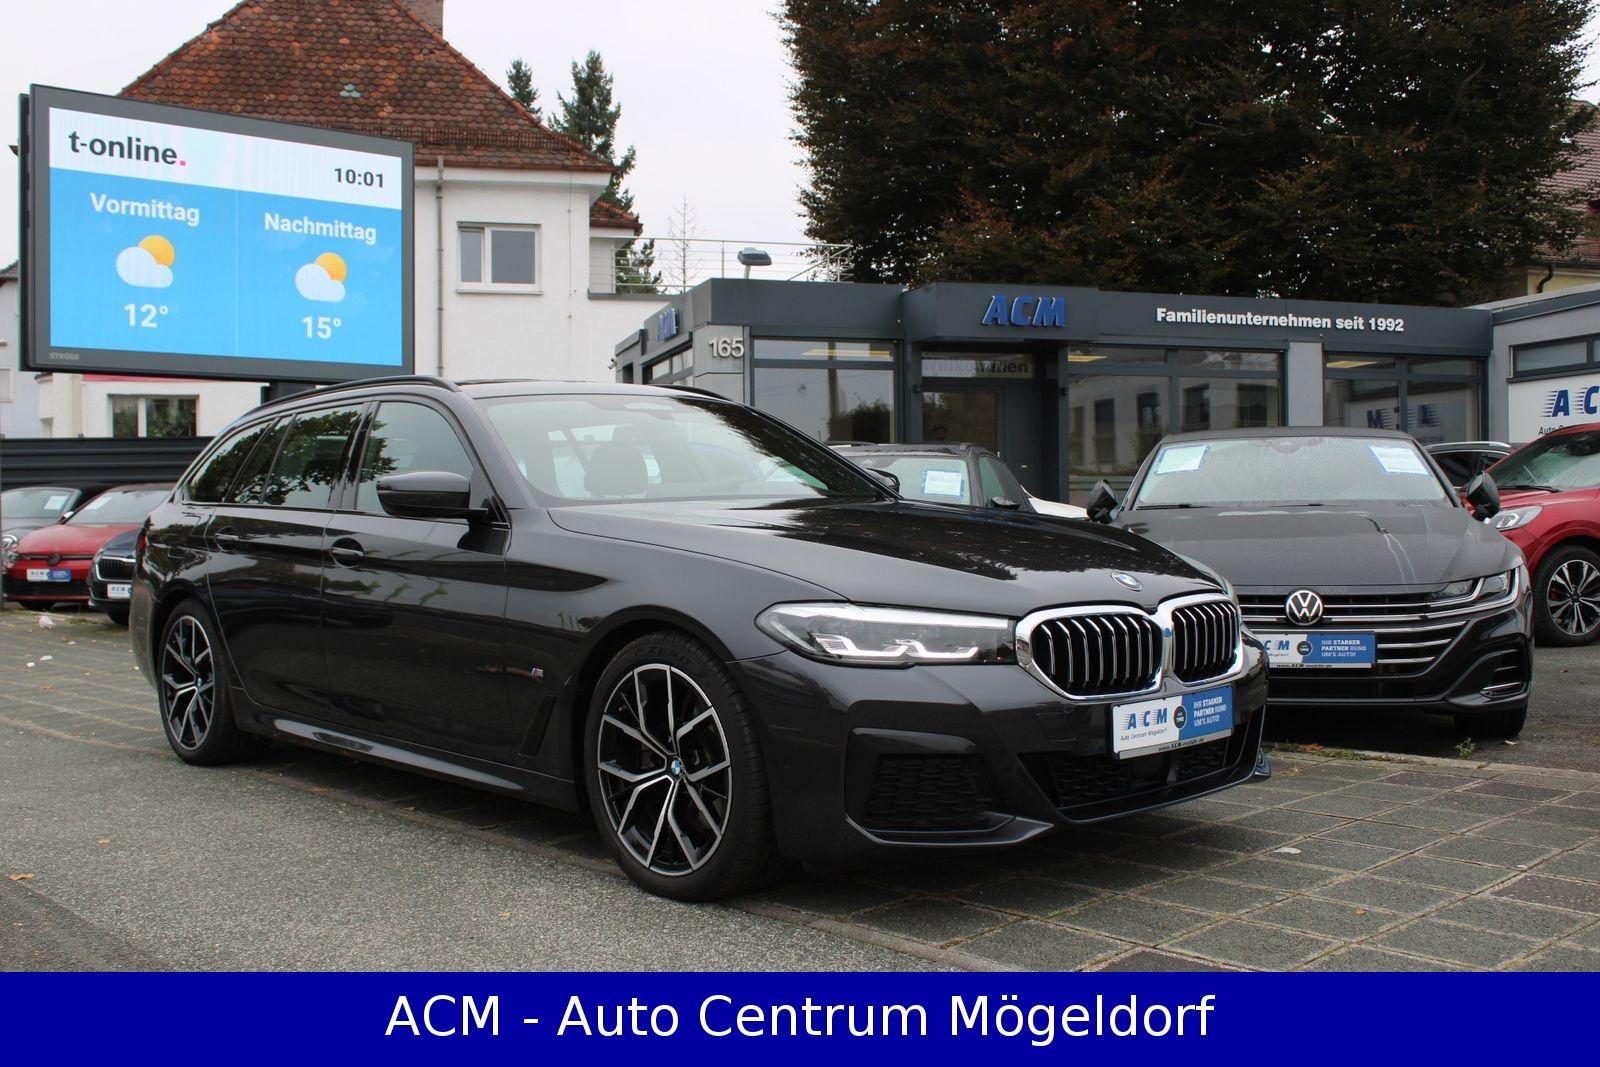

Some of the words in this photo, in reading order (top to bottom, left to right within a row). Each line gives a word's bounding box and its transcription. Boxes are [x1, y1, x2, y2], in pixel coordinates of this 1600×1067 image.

[68, 130, 187, 166] t-online.
[333, 167, 385, 188] 10:01
[89, 192, 200, 227] Vormittag
[264, 212, 377, 245] Nachmittag
[123, 303, 169, 329] 12°
[981, 294, 1067, 328] ACM
[1156, 307, 1332, 331] Familienunternehmen
[1335, 314, 1364, 331] seit
[1368, 316, 1405, 333] 1992
[302, 316, 342, 340] 15°
[708, 337, 745, 358] 165
[1124, 707, 1168, 730] ACM
[1193, 706, 1215, 718] PARTNER
